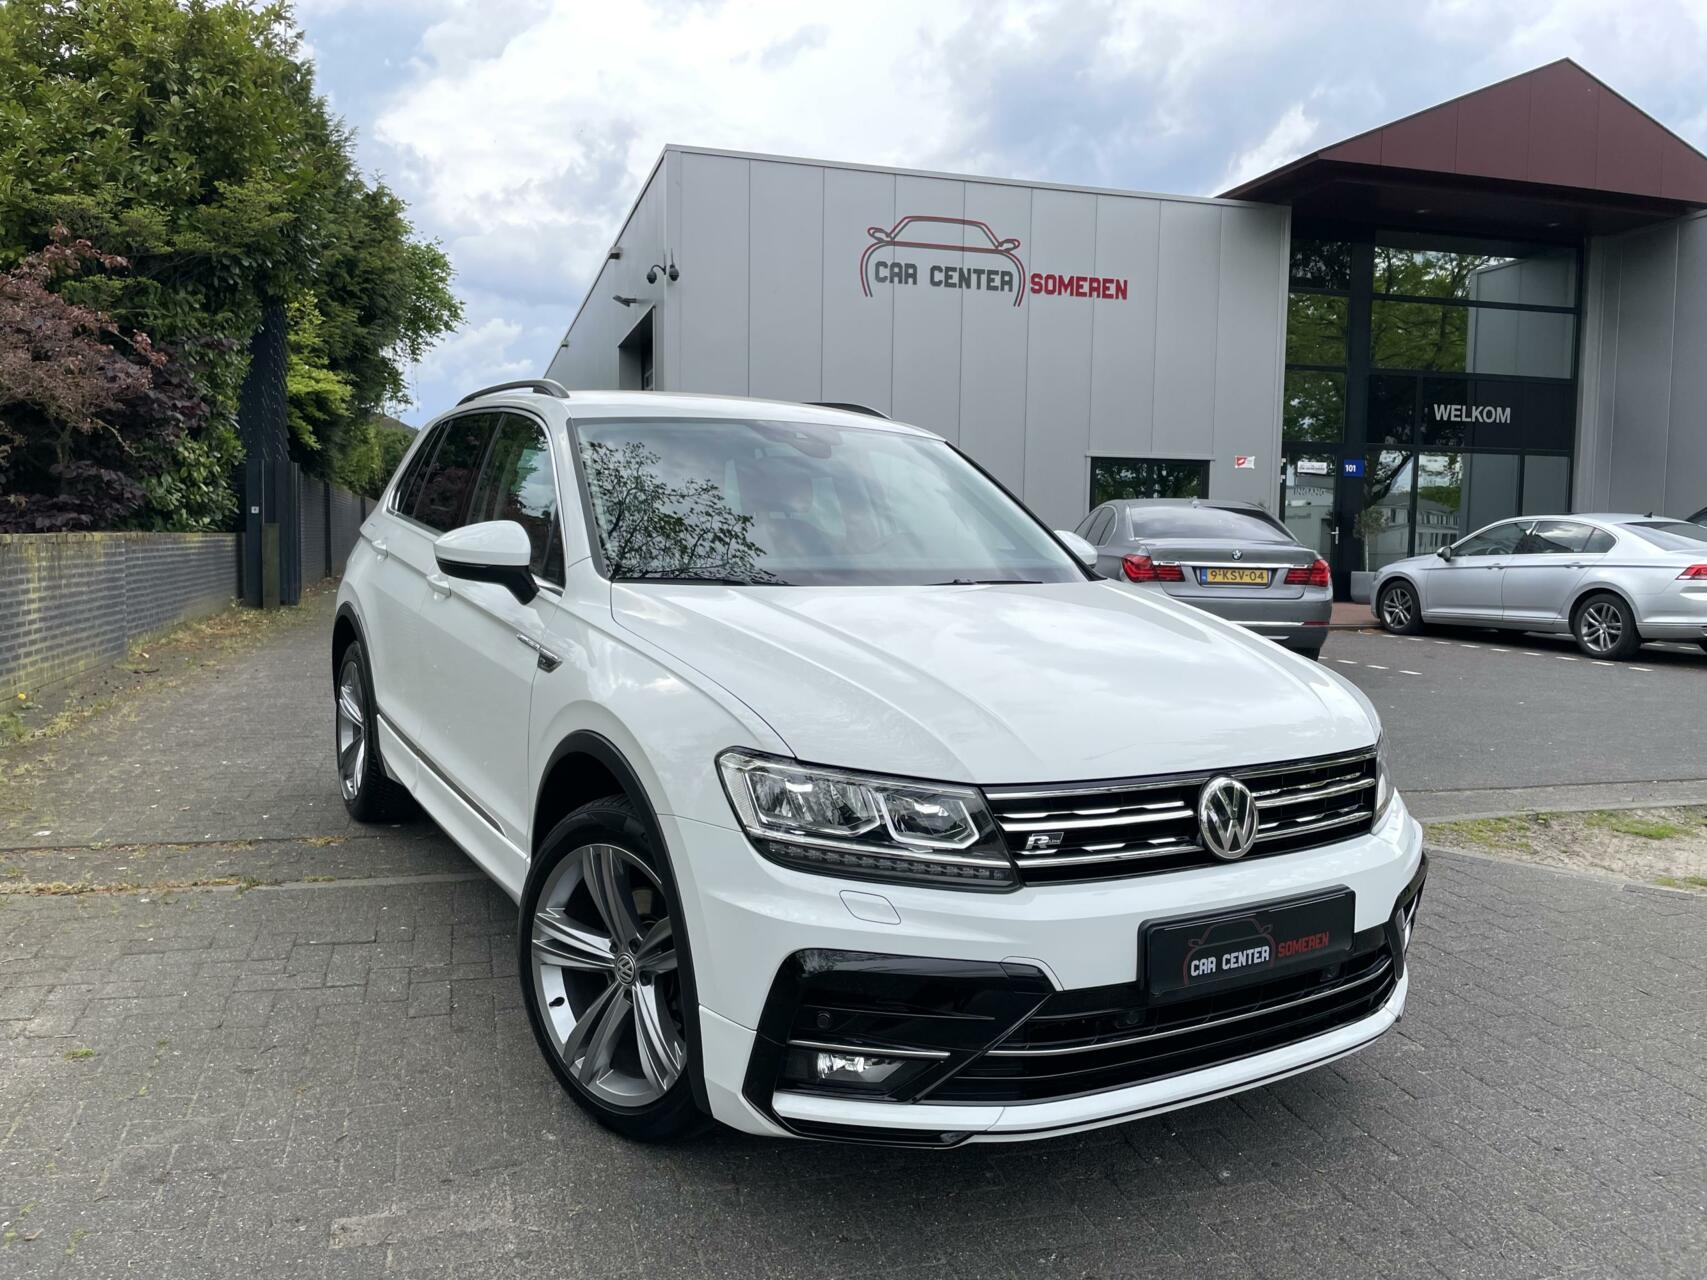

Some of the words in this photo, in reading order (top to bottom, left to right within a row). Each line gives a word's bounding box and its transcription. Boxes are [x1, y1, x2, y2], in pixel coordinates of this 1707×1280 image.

[874, 261, 918, 285] CAR
[929, 265, 1014, 292] CENTER
[1030, 273, 1128, 300] SOMEREN
[1433, 403, 1511, 424] WELKOM
[1344, 464, 1357, 473] 101
[1210, 570, 1264, 581] 9-KSV-04
[1190, 956, 1216, 977] CAR
[1222, 946, 1270, 970] CENTER
[1278, 931, 1329, 957] SOMEREN
